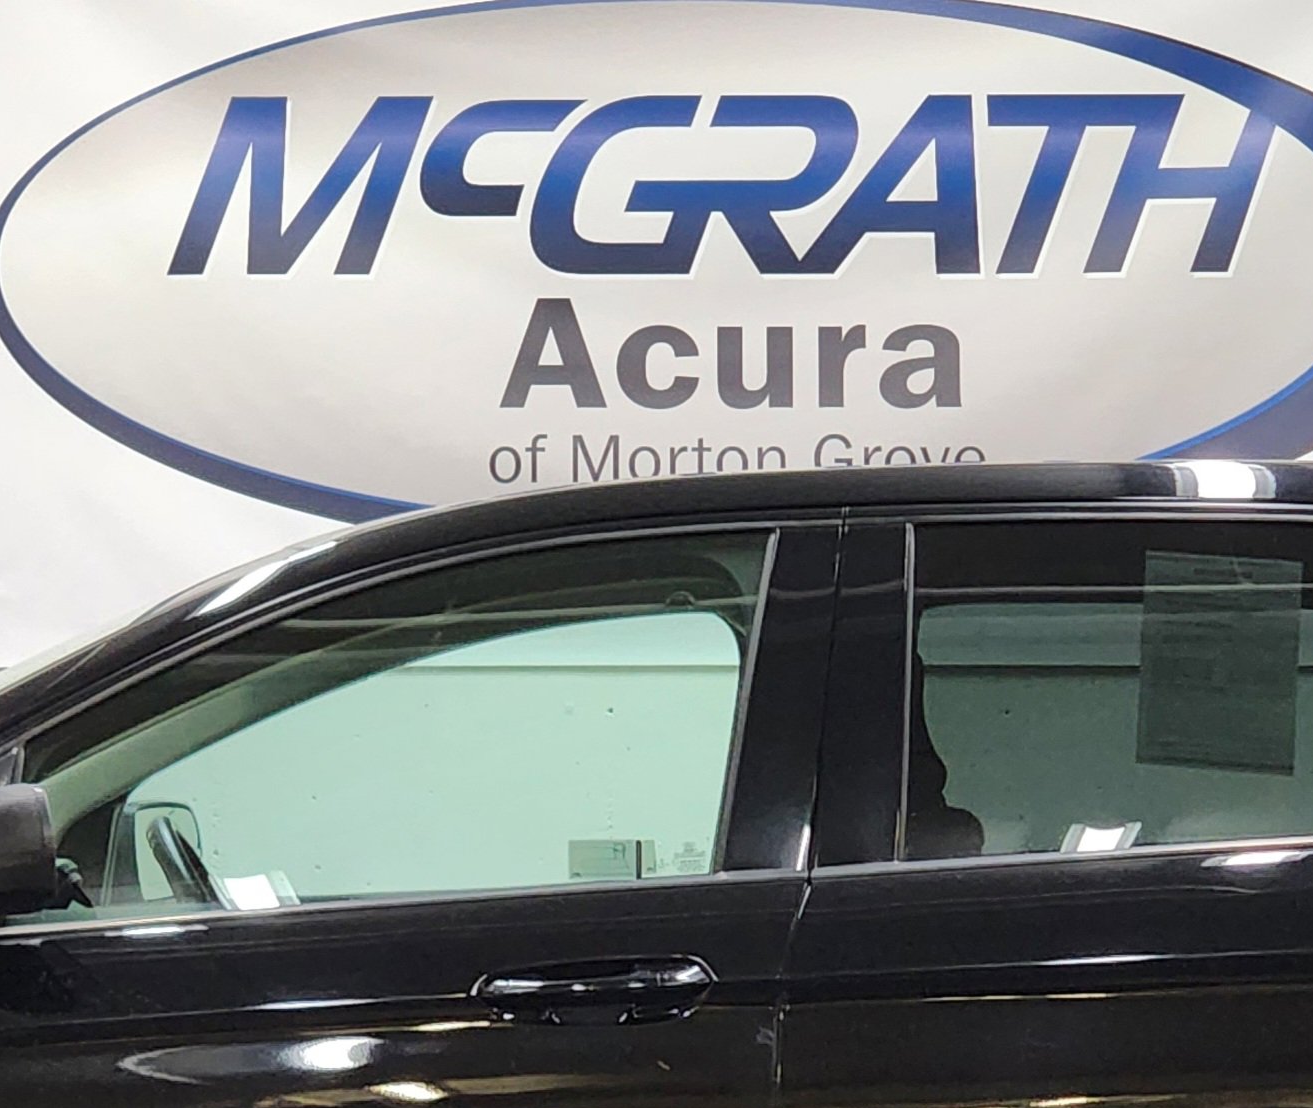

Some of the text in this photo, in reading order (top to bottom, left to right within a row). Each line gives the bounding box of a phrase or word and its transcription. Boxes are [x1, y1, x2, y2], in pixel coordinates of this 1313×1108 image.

[499, 297, 963, 410] Acura
[488, 433, 548, 484] of
[571, 433, 788, 483] Morton
